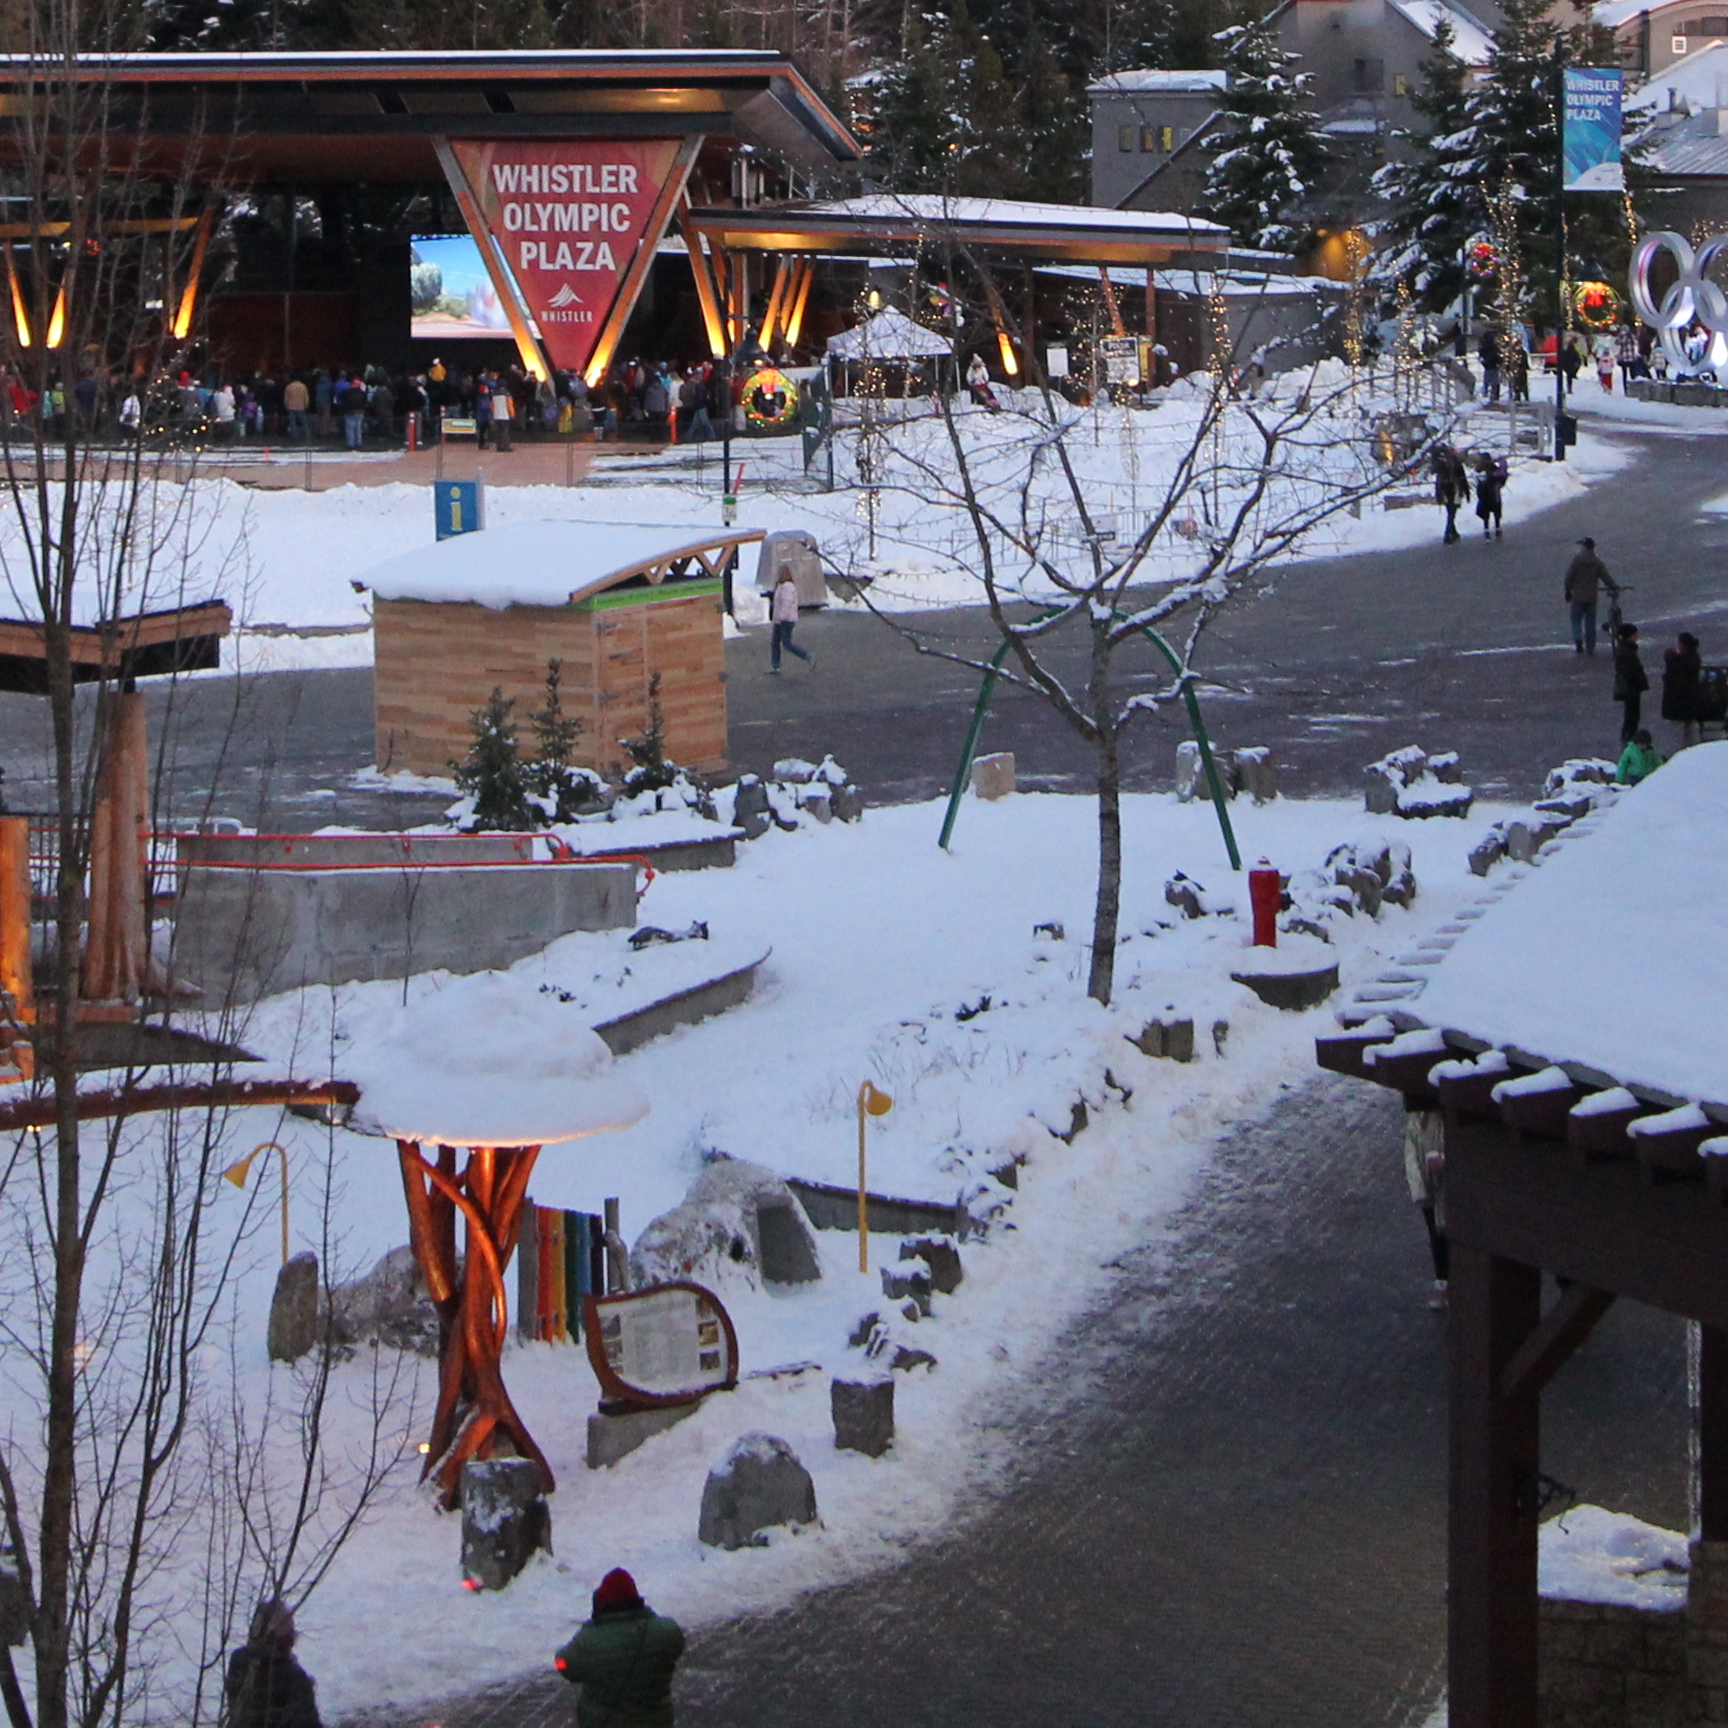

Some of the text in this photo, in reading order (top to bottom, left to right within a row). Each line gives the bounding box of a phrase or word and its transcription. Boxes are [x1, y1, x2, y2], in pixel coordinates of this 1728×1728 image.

[1567, 79, 1619, 91] WHISTLER
[1567, 94, 1613, 106] OLYMPIC
[1567, 109, 1601, 121] PLAZA
[492, 163, 639, 194] WHISTLER
[503, 201, 632, 232] OLYMPIC
[520, 240, 617, 271] PLAZA
[541, 310, 593, 323] WHISTLER
